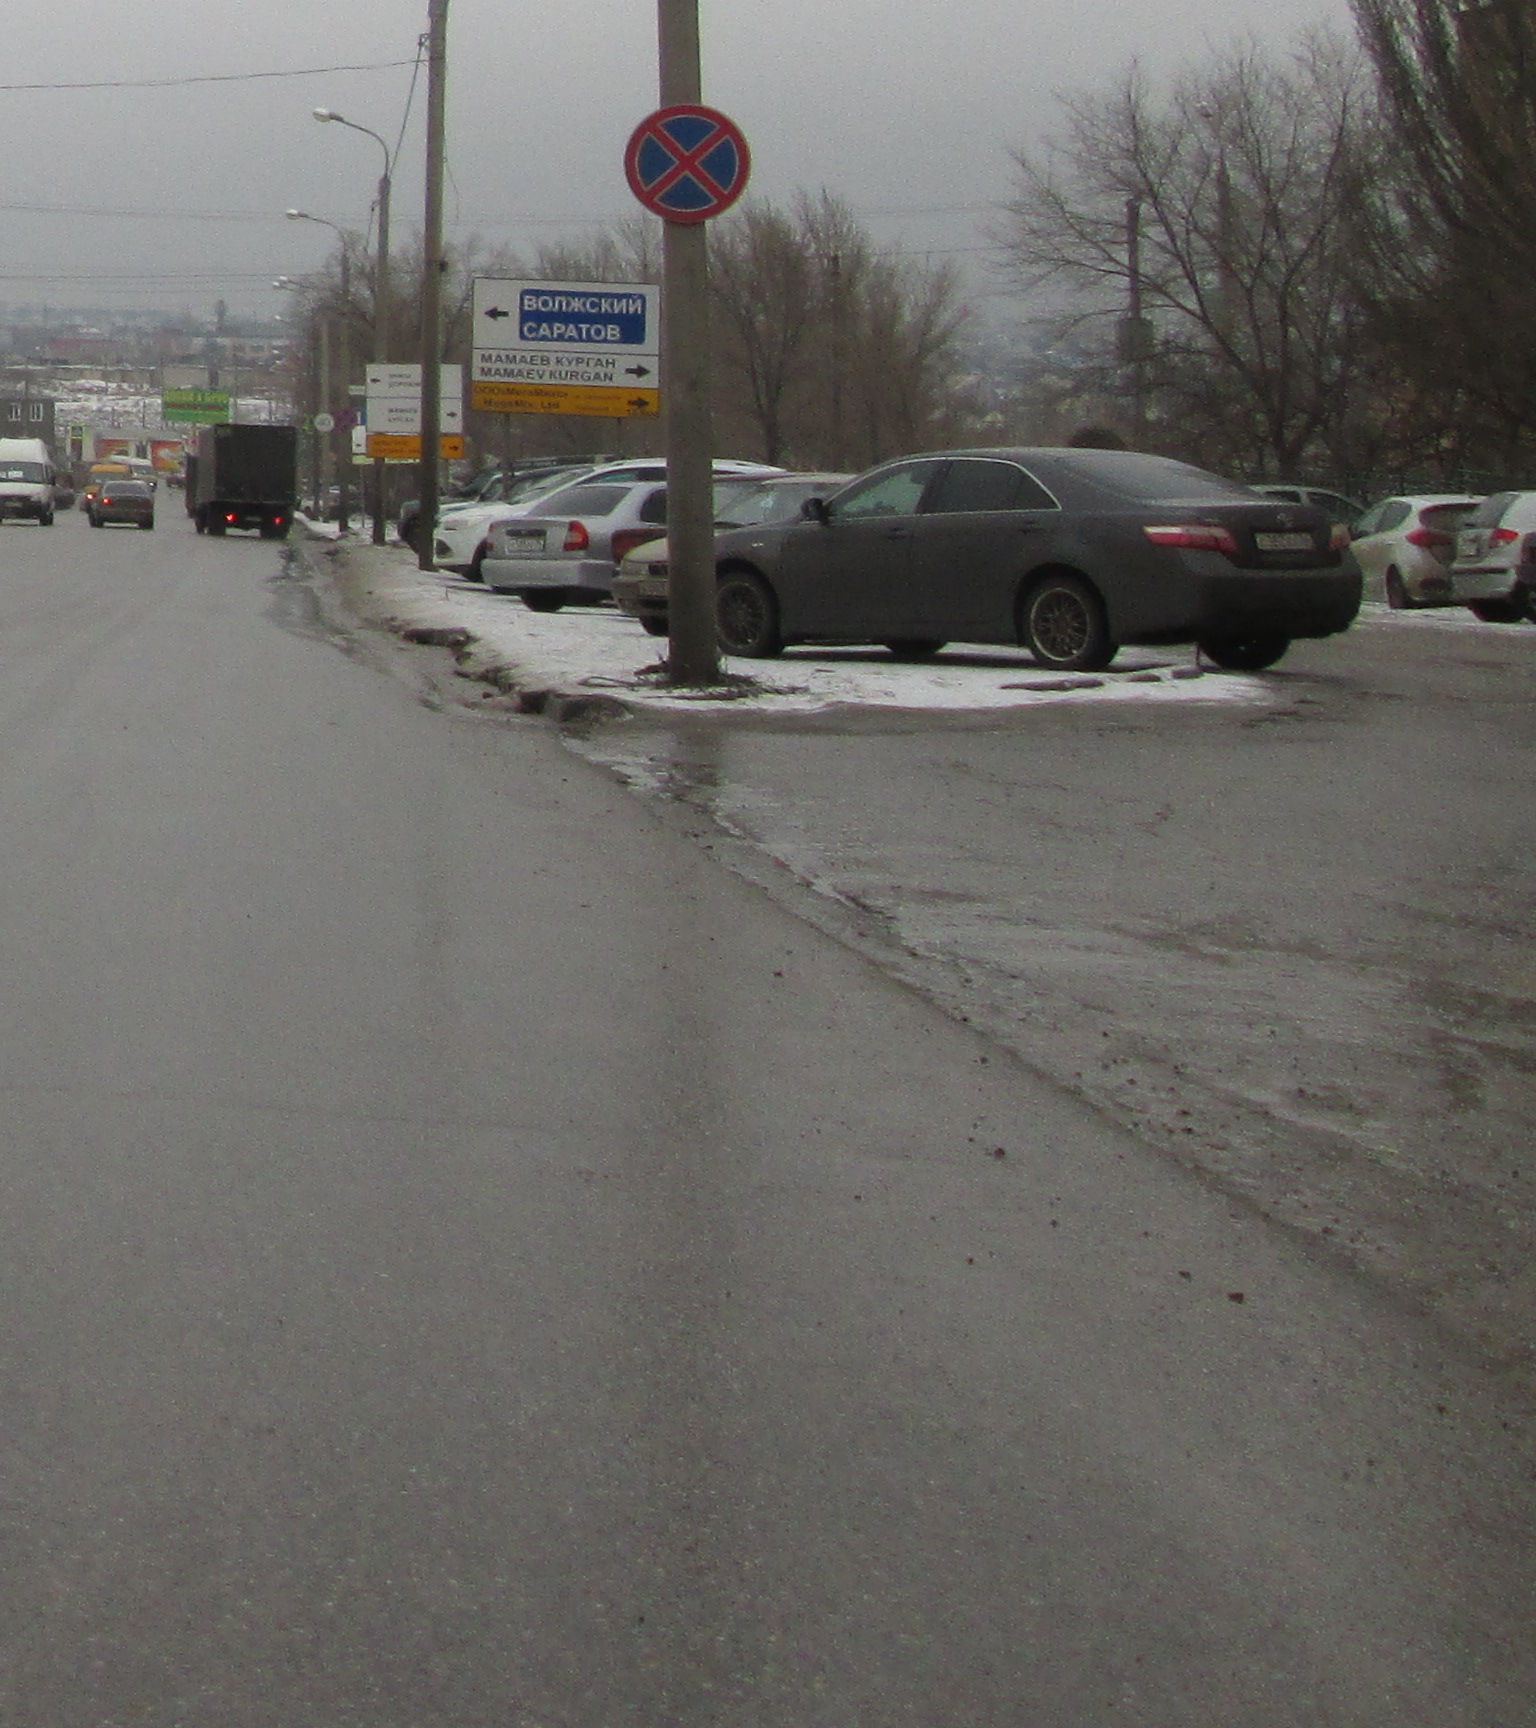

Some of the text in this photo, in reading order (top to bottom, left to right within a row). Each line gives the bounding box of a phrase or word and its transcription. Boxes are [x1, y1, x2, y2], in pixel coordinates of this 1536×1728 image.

[523, 294, 644, 315] ВОЛЖСКИЙ
[523, 322, 621, 341] САРАТОВ
[480, 352, 617, 369] МАМАЕВ КУРГАН
[480, 366, 614, 383] MAMAEV KURGAN
